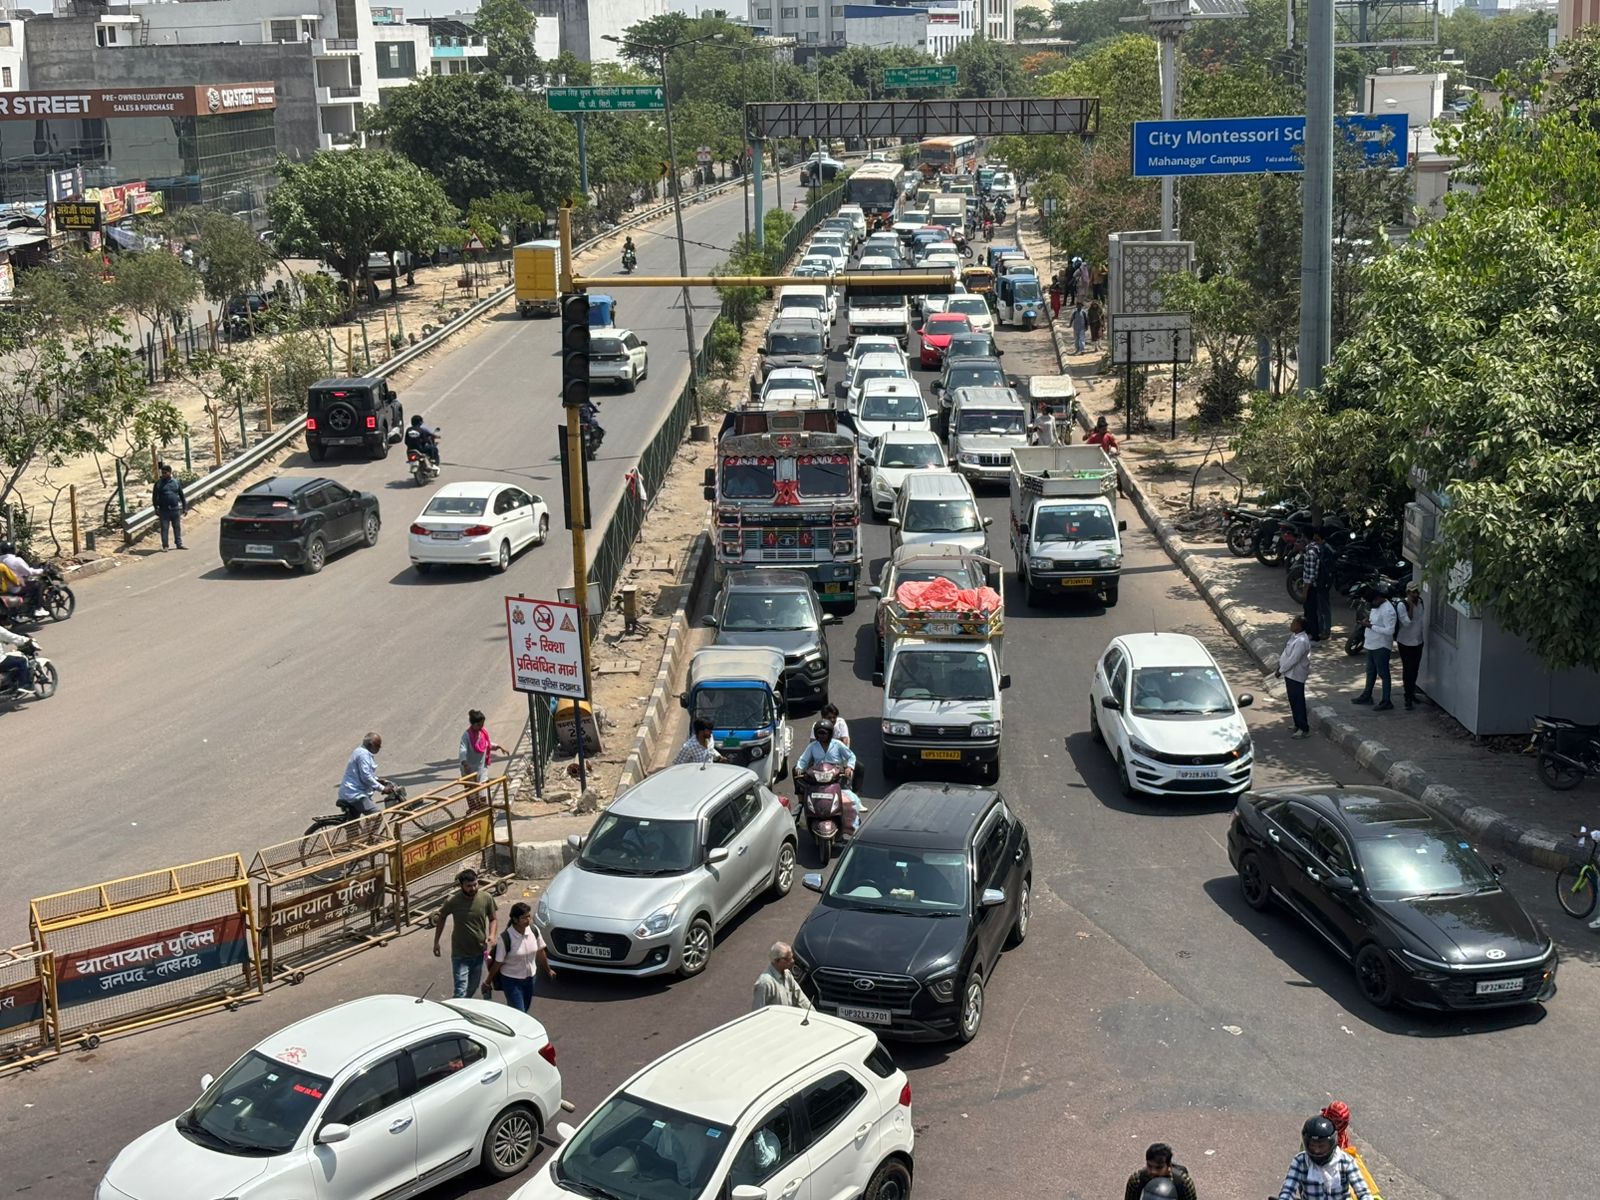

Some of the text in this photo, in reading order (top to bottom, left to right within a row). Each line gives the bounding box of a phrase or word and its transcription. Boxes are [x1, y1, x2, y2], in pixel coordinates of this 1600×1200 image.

[13, 95, 91, 114] STREET
[1148, 126, 1306, 148] City Montessori Sc
[1148, 156, 1206, 168] Mahanagar
[1210, 154, 1251, 165] Campus
[539, 635, 565, 654] रिक्शा
[517, 654, 577, 677] प्रतिबंधित मार्ग
[272, 879, 376, 926] यातायात पुलिस
[76, 929, 215, 975] यातायात पुलिस
